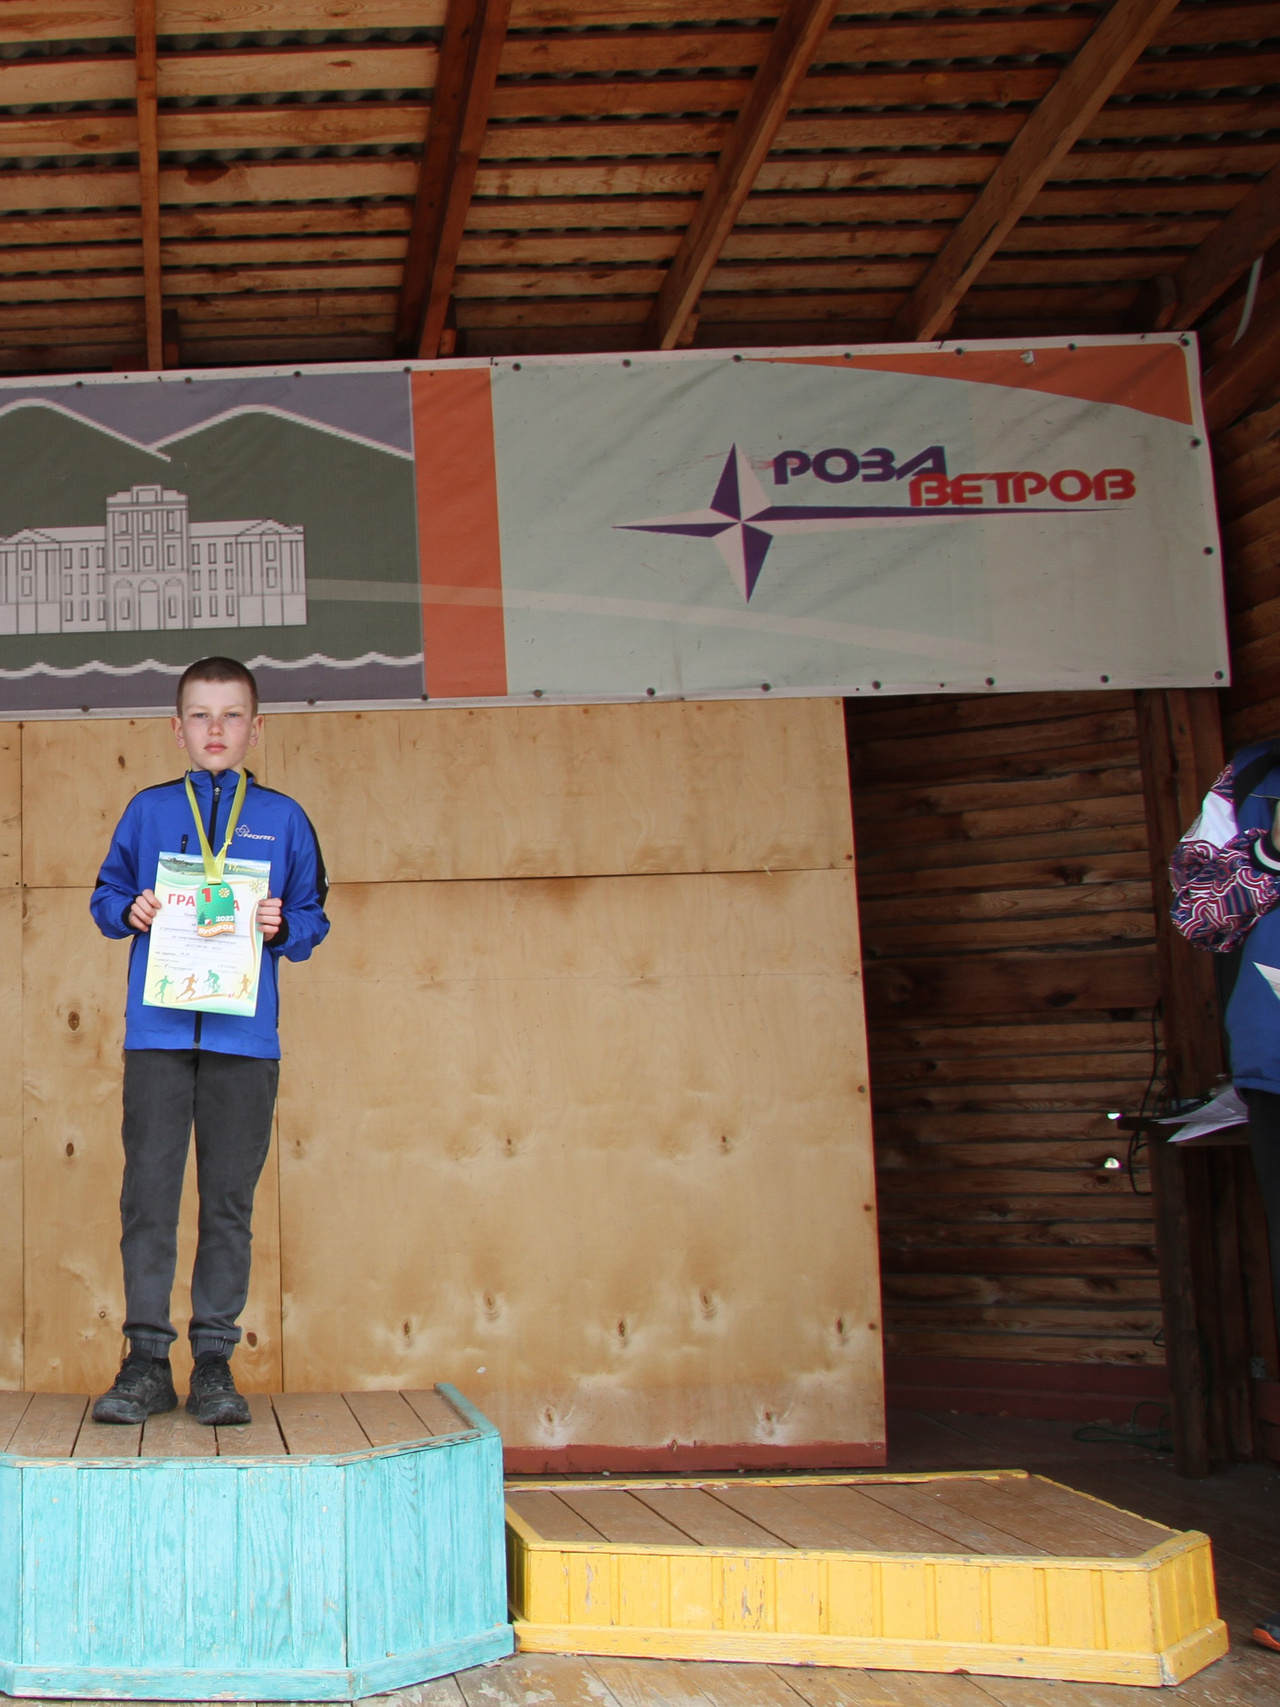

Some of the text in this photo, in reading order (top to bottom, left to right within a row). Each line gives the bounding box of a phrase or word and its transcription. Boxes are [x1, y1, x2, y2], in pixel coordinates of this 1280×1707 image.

[773, 445, 948, 485] РОЗА
[909, 468, 1137, 507] ВЕТРОВ
[167, 893, 241, 912] ГРАА
[201, 887, 212, 903] 1
